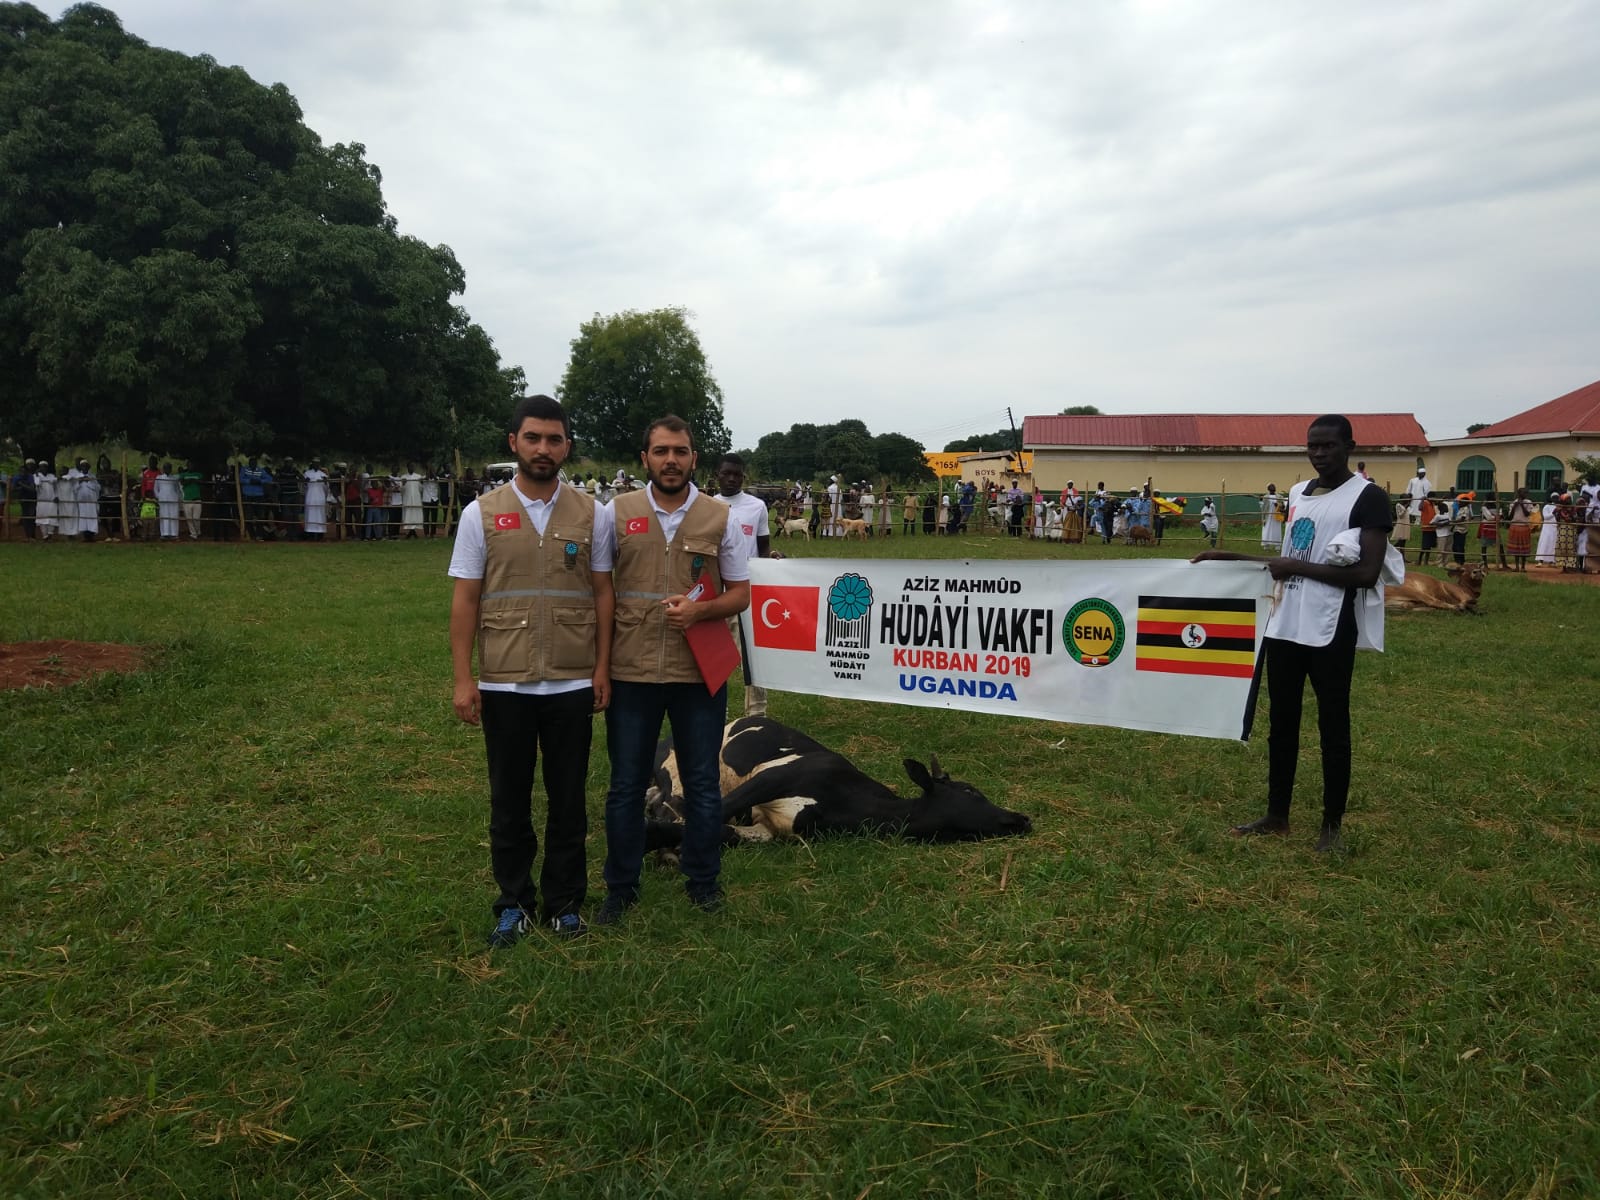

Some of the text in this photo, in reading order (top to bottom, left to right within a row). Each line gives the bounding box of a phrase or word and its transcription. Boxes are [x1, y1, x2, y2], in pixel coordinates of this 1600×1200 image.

[975, 469, 996, 477] BOYS
[903, 576, 1022, 594] AZİZ MAHMÛD
[880, 595, 969, 650] HÜDÂYİ
[977, 607, 1053, 655] VAKFI
[1074, 625, 1113, 641] SENA
[893, 648, 1031, 678] KURBAN 2019
[833, 671, 862, 681] VAKFI
[899, 674, 1018, 701] UGANDA
